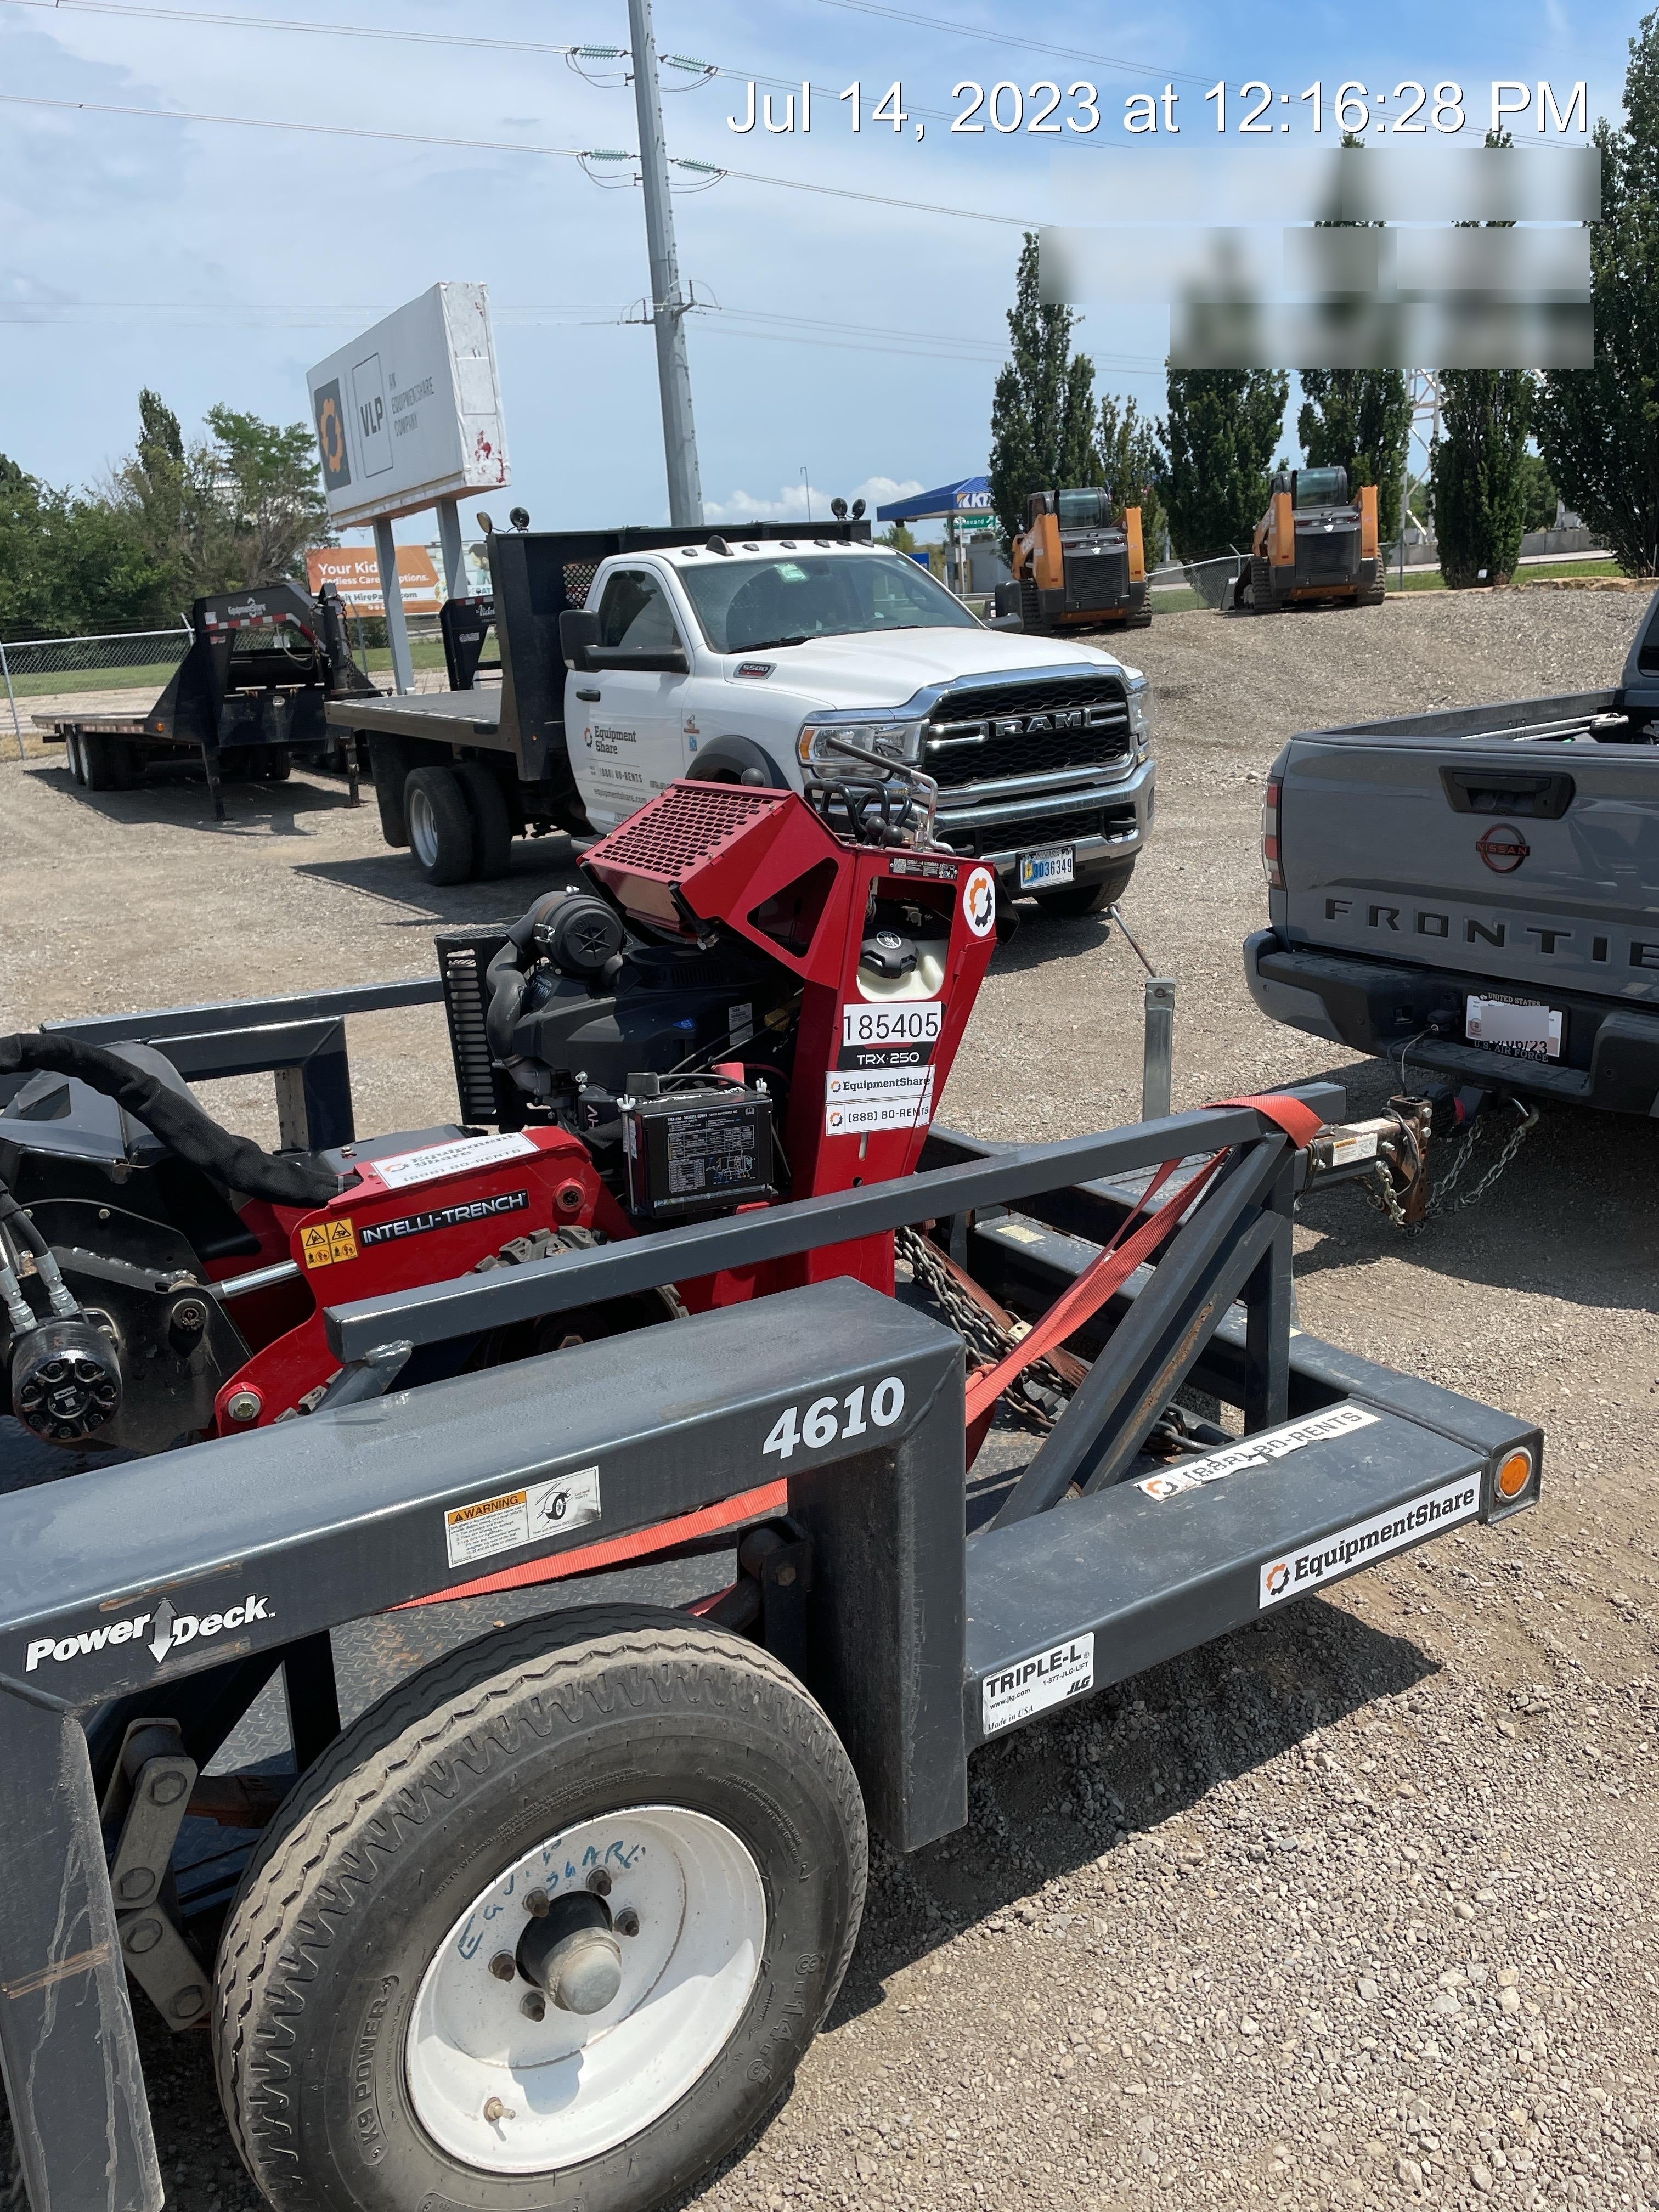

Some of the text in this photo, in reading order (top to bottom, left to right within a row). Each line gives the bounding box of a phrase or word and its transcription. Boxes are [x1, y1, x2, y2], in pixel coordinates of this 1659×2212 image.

[360, 396, 383, 437] VLP
[318, 563, 351, 575] Your
[359, 576, 380, 584] Care
[399, 574, 430, 584] ptions.
[594, 726, 637, 742] Equipment
[995, 711, 1081, 736] RAM
[596, 741, 618, 755] Share
[615, 770, 643, 783] 80-RENTS
[594, 788, 648, 804] equipmentshare.com
[1476, 842, 1529, 857] NISSAN
[1488, 992, 1541, 1007] UNITED STATES
[844, 1012, 939, 1040] 185405
[1494, 1045, 1511, 1055] AIR
[1514, 1049, 1549, 1063] FORCE
[843, 1077, 930, 1092] EquipmentShare
[849, 1106, 929, 1124] (888) 80-RENTS
[411, 1134, 517, 1164] Equipment
[414, 1150, 472, 1168] Share
[403, 1149, 521, 1182] (888) 80-RENTS
[363, 1193, 524, 1244] INTELLI-TRENCH
[763, 1376, 905, 1459] 4610
[1252, 1412, 1363, 1455] 80-RENTS
[464, 1496, 519, 1519] WARNING
[1294, 1488, 1475, 1582] EquipmentShare
[25, 1594, 269, 1672] Power Deck
[986, 1644, 1082, 1699] TRIPLE-L
[1042, 1661, 1089, 1686] 1-877-JLG-LIFT
[989, 1674, 1091, 1710] www.jlg.com JLG
[987, 1705, 1034, 1731] Made in USA
[434, 1870, 460, 1898] SAFETY
[356, 1998, 388, 2146] K9 POWER
